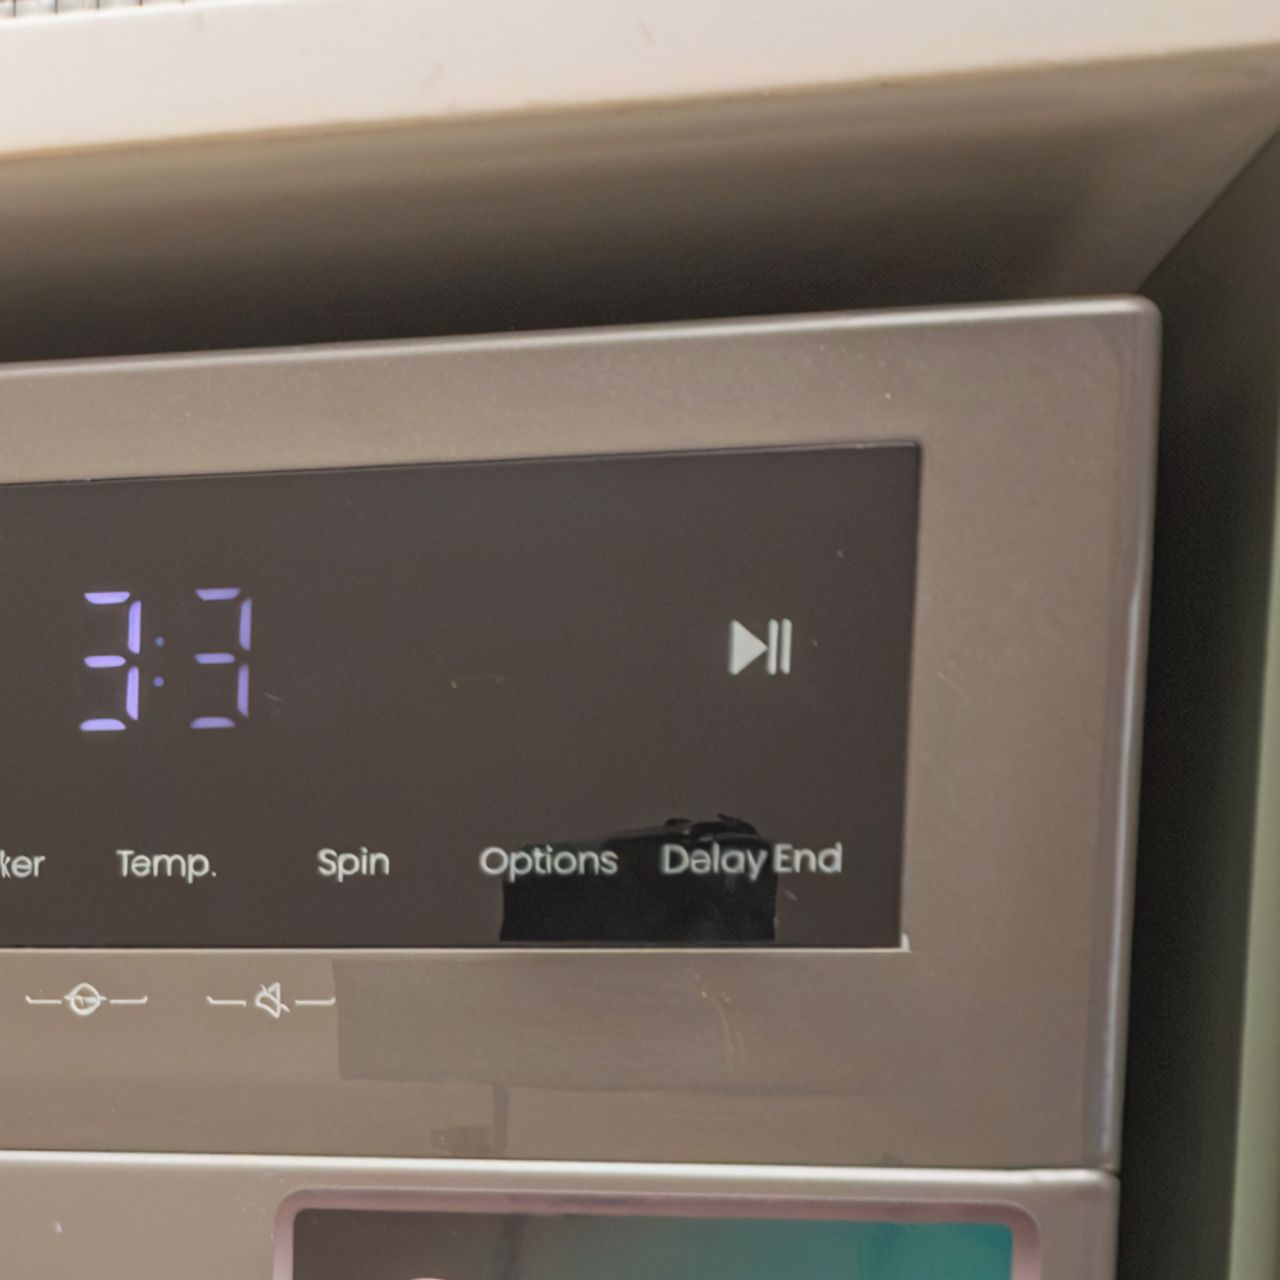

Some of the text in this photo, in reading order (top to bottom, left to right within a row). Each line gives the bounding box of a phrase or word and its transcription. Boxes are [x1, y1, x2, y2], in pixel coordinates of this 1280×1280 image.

[116, 849, 217, 884] Temp.
[317, 846, 390, 883] Spin
[479, 845, 618, 882] Options
[774, 842, 843, 873] End
